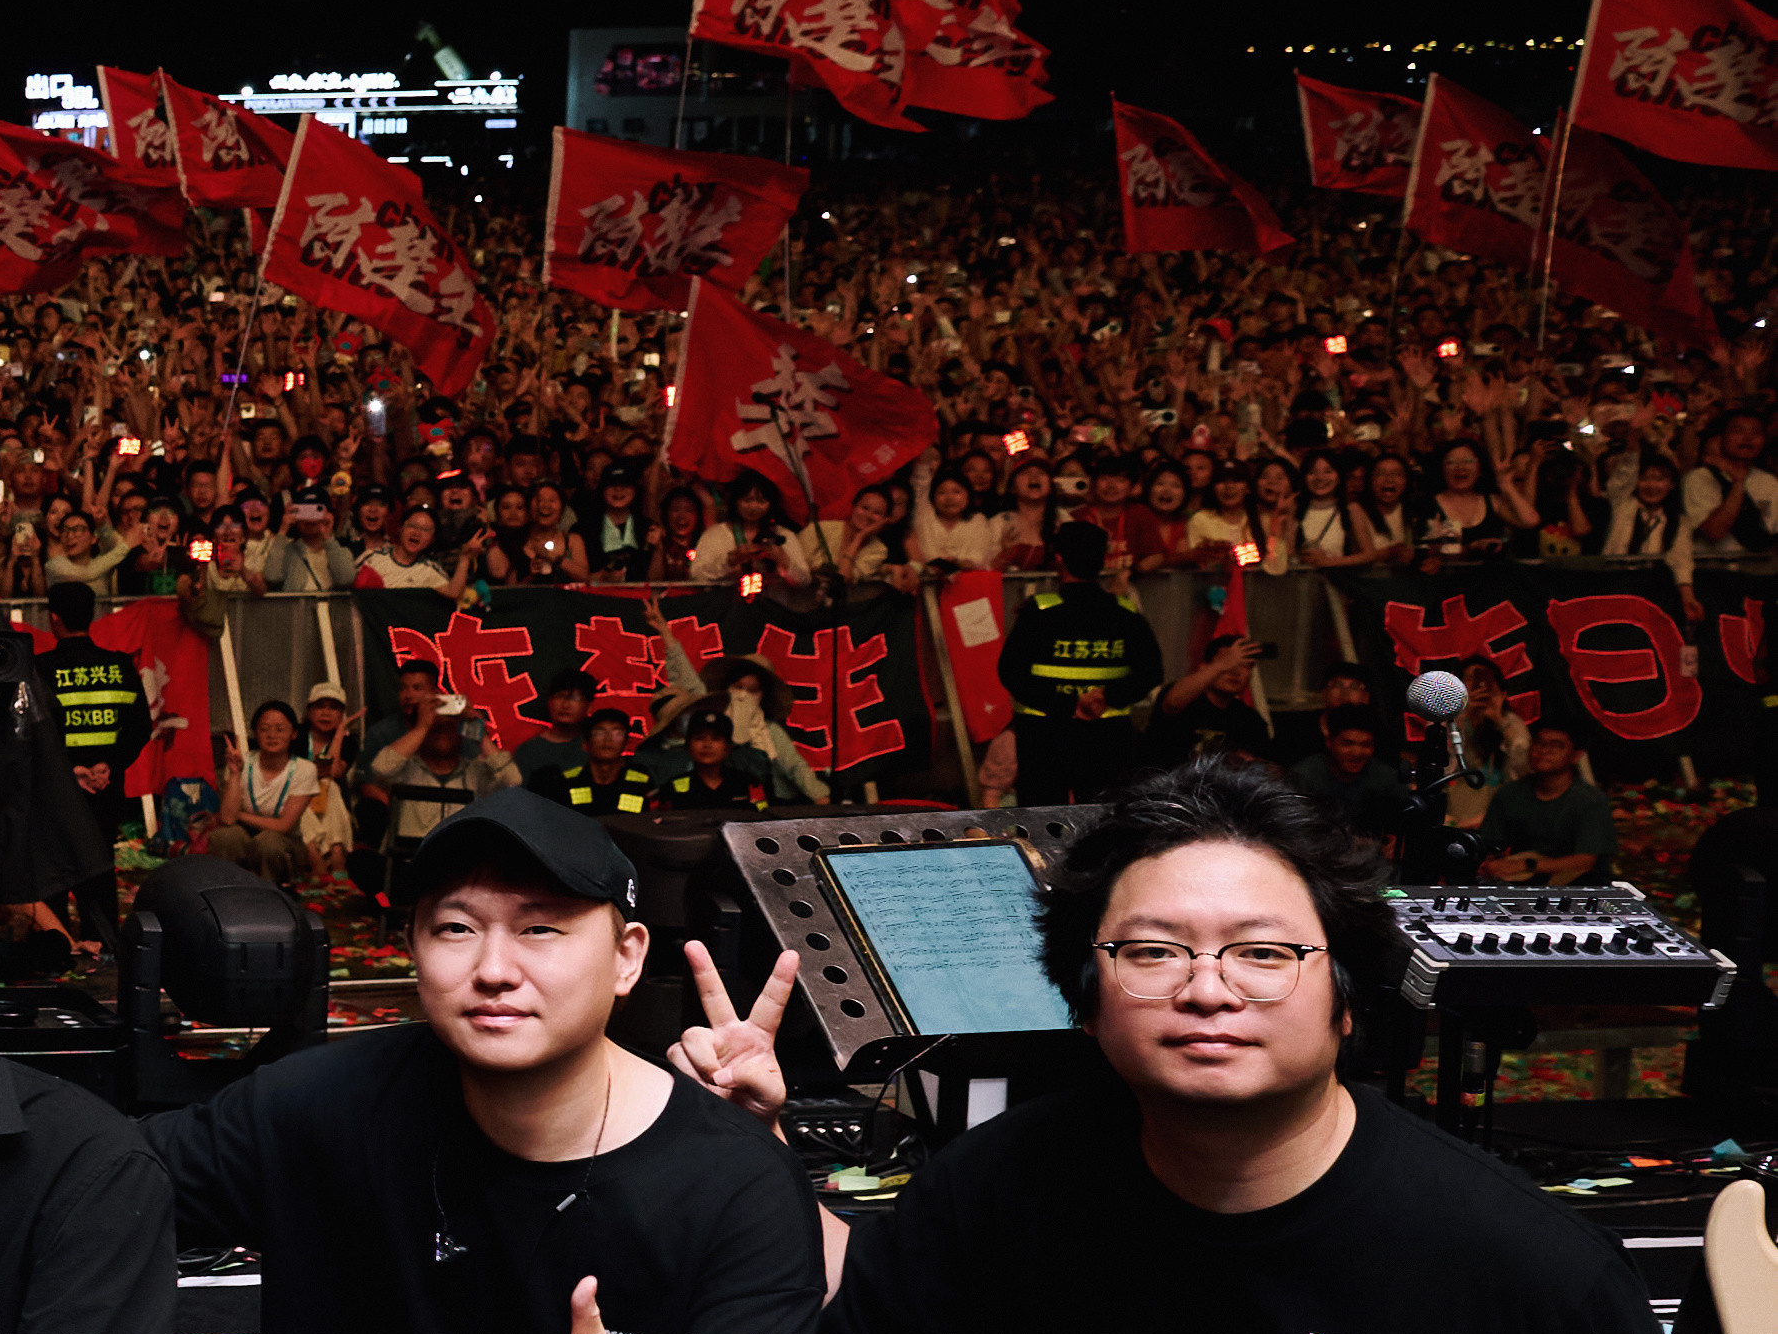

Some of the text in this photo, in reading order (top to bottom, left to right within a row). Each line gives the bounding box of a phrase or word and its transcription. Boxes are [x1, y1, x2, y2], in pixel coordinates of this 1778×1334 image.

[56, 665, 123, 687] 江苏兴兵
[65, 709, 118, 726] JSXBB
